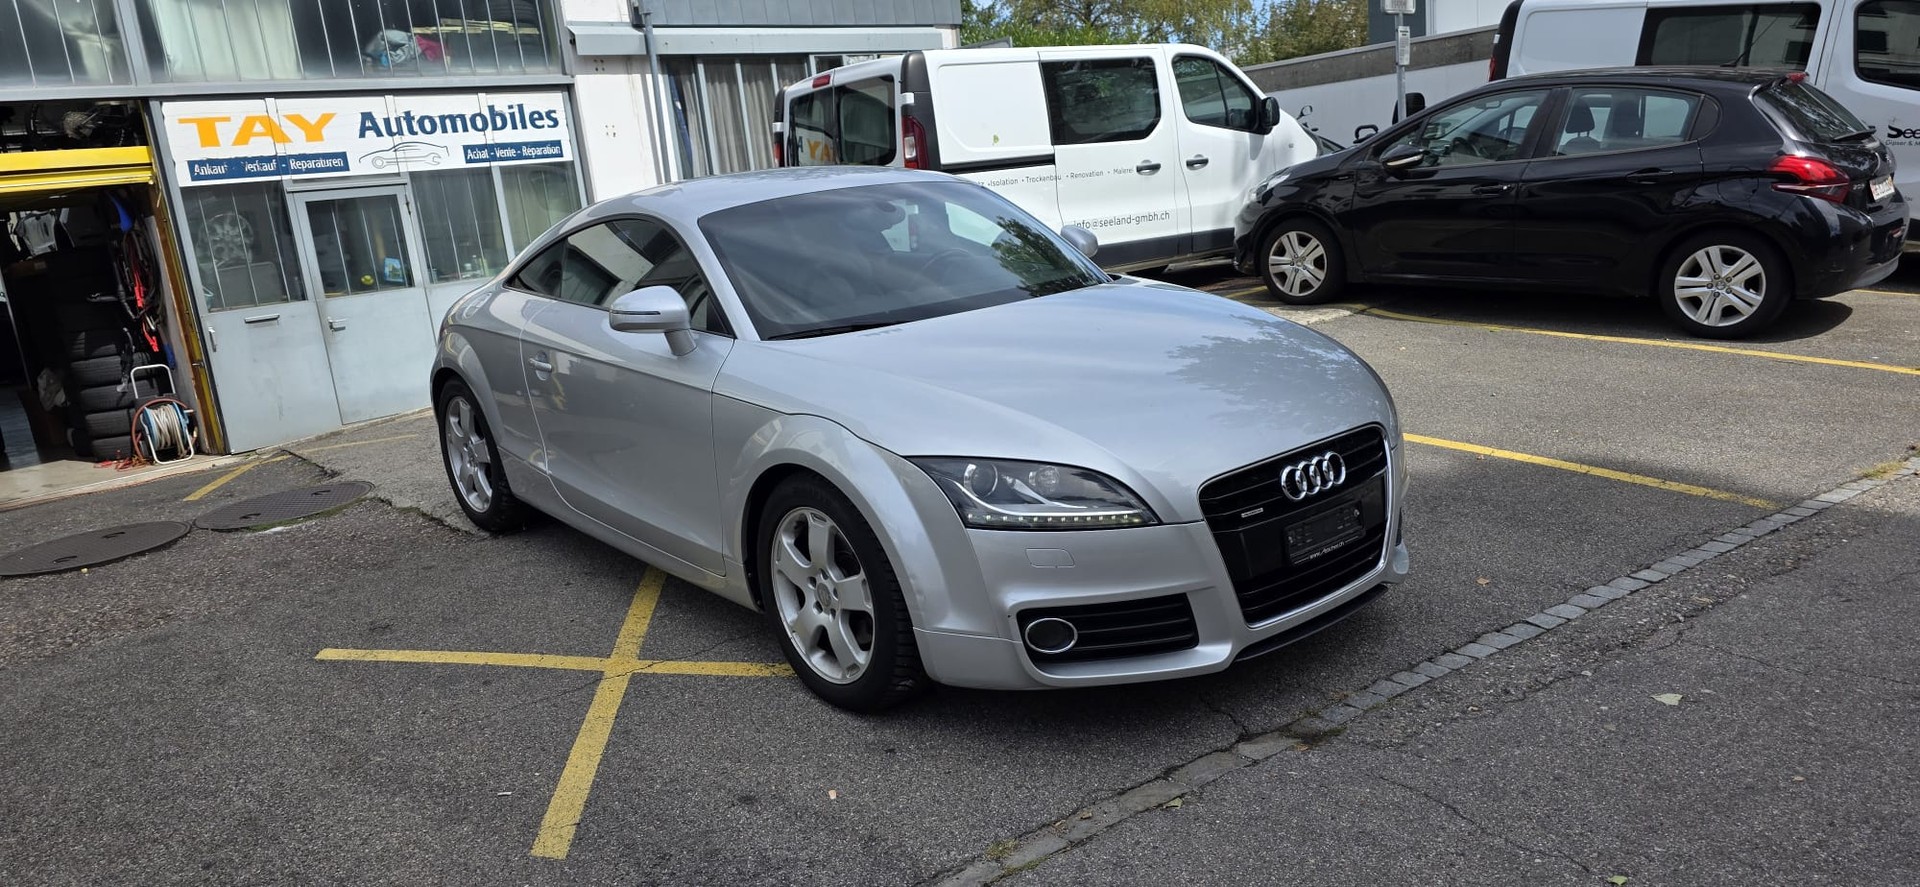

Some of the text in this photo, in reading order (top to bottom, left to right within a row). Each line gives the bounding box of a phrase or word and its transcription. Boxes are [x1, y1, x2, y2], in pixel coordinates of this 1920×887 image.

[178, 103, 559, 148] TAY Automobiles
[467, 149, 489, 160] Achat
[494, 147, 516, 158] Vente
[290, 157, 344, 171] Reparaturen
[1025, 173, 1062, 184] Trockenbau
[1070, 171, 1104, 179] Renovation
